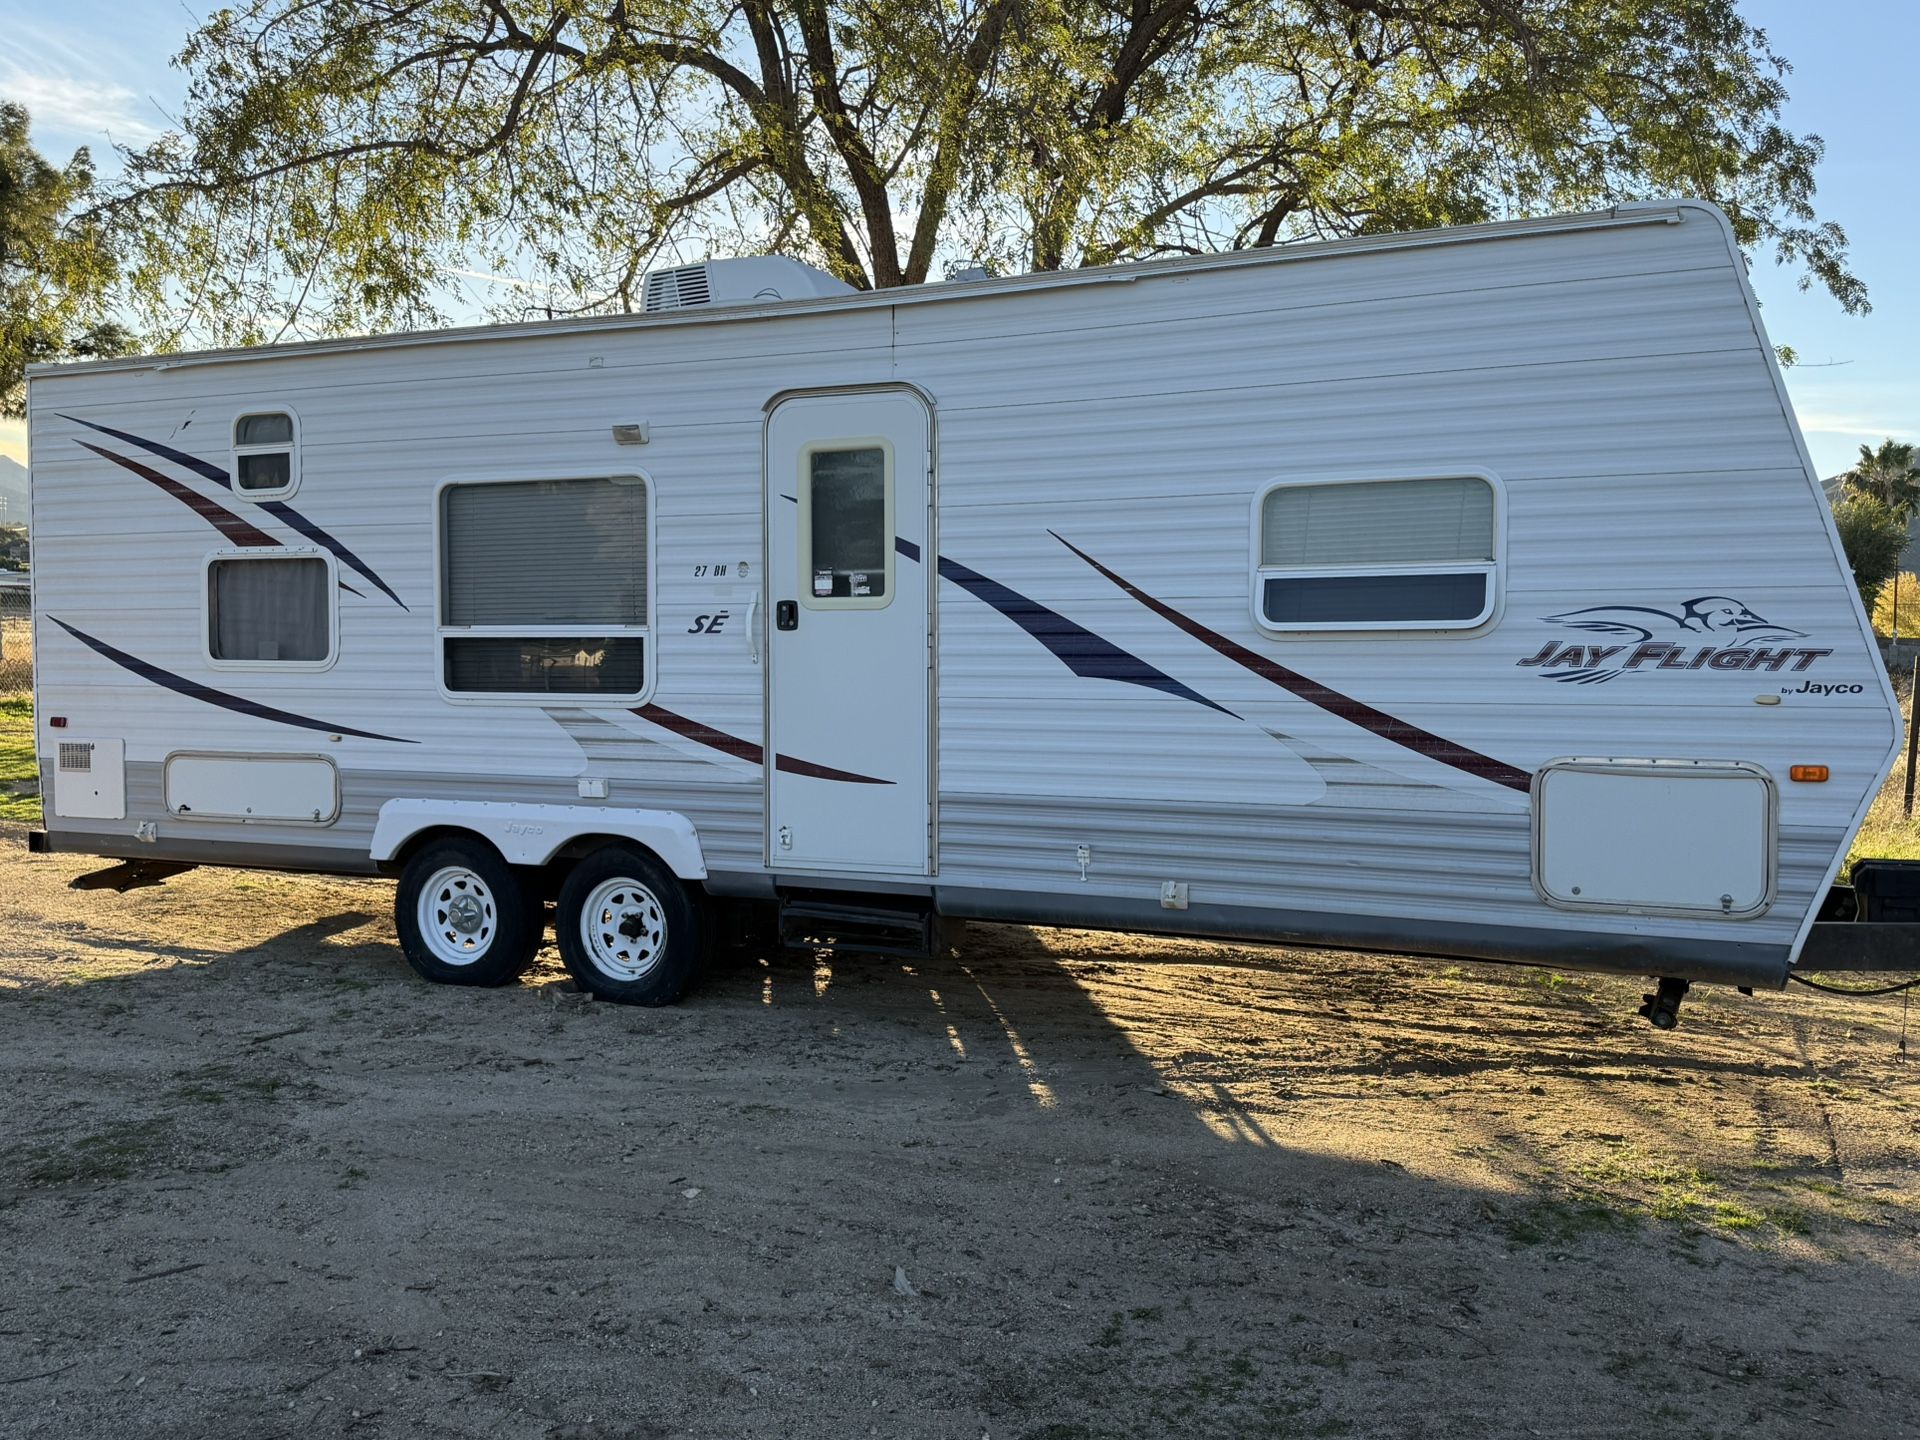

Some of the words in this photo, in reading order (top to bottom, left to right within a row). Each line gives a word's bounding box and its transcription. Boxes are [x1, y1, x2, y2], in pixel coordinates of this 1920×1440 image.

[694, 565, 708, 577] 27
[713, 565, 727, 577] BH
[1516, 641, 1626, 668] JAY
[1623, 642, 1834, 672] FLIGHT
[1781, 687, 1794, 695] by
[1795, 680, 1864, 695] Jayco
[504, 820, 544, 836] Jayco
